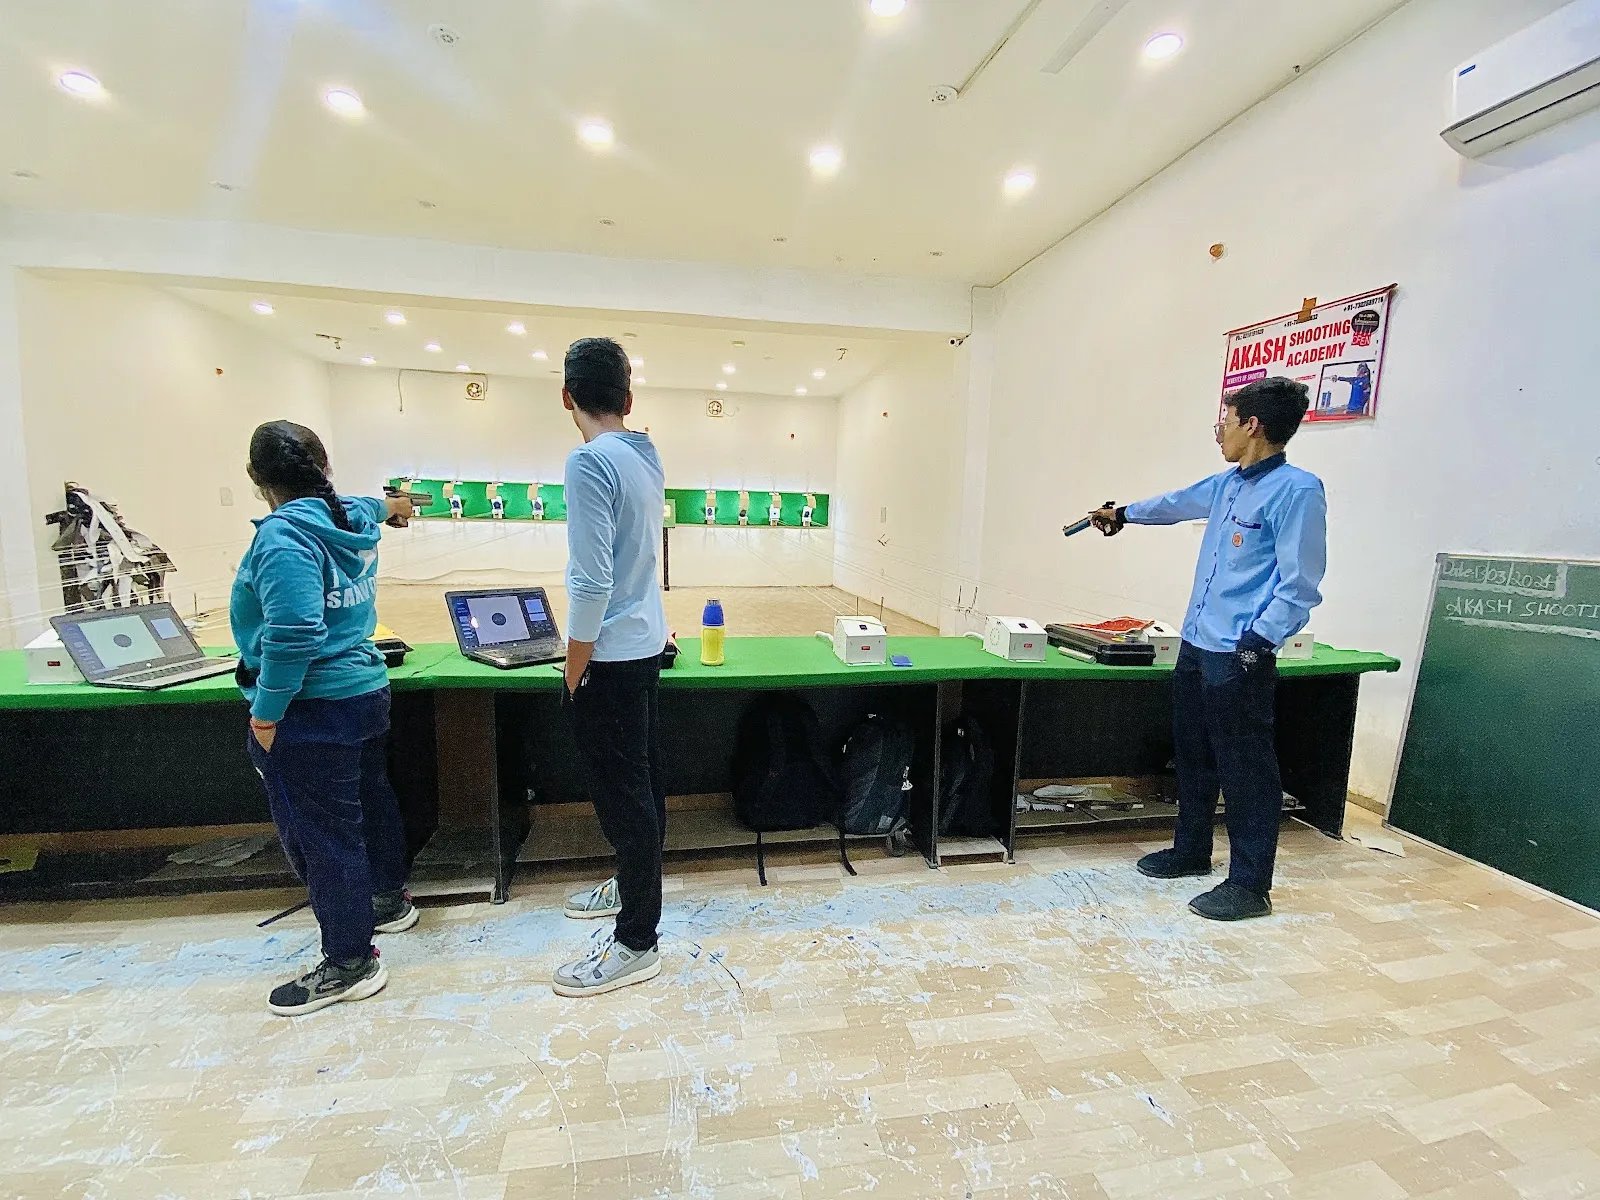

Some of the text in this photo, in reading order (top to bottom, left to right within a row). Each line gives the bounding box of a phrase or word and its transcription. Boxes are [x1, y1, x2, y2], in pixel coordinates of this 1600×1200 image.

[1228, 335, 1287, 372] AKASH
[1289, 319, 1351, 347] SHOOTING
[1286, 342, 1346, 368] ACADEMY
[1446, 596, 1600, 619] AKASH SHOOTI
